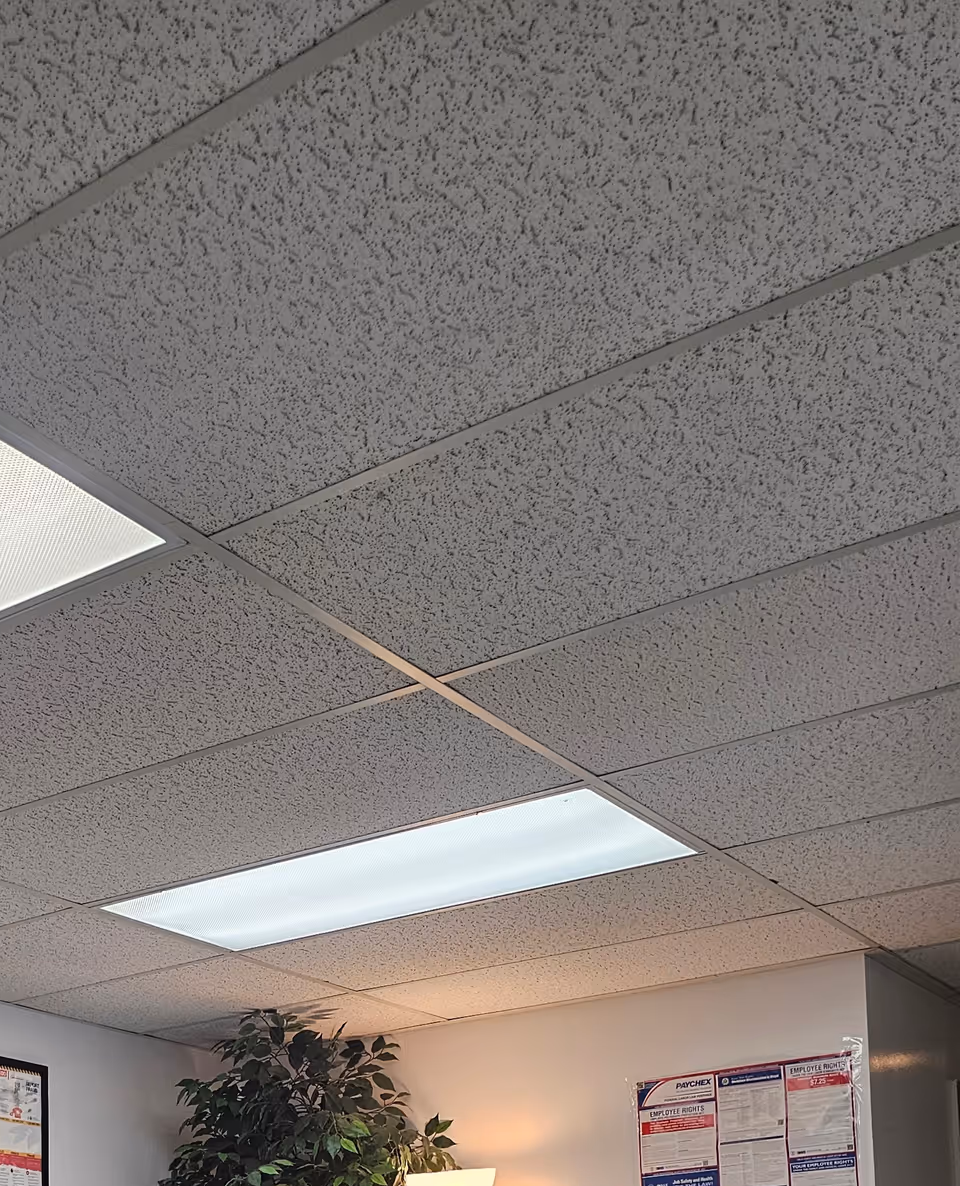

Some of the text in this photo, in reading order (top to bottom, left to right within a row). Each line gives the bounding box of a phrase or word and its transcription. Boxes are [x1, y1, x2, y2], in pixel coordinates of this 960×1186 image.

[790, 1064, 822, 1075] EMPLOYEE
[823, 1061, 846, 1070] RIGHTS
[675, 1078, 712, 1090] PAYCHEX
[810, 1078, 827, 1086] $7.25
[649, 1105, 705, 1118] EMPLOYEE RIGHTS
